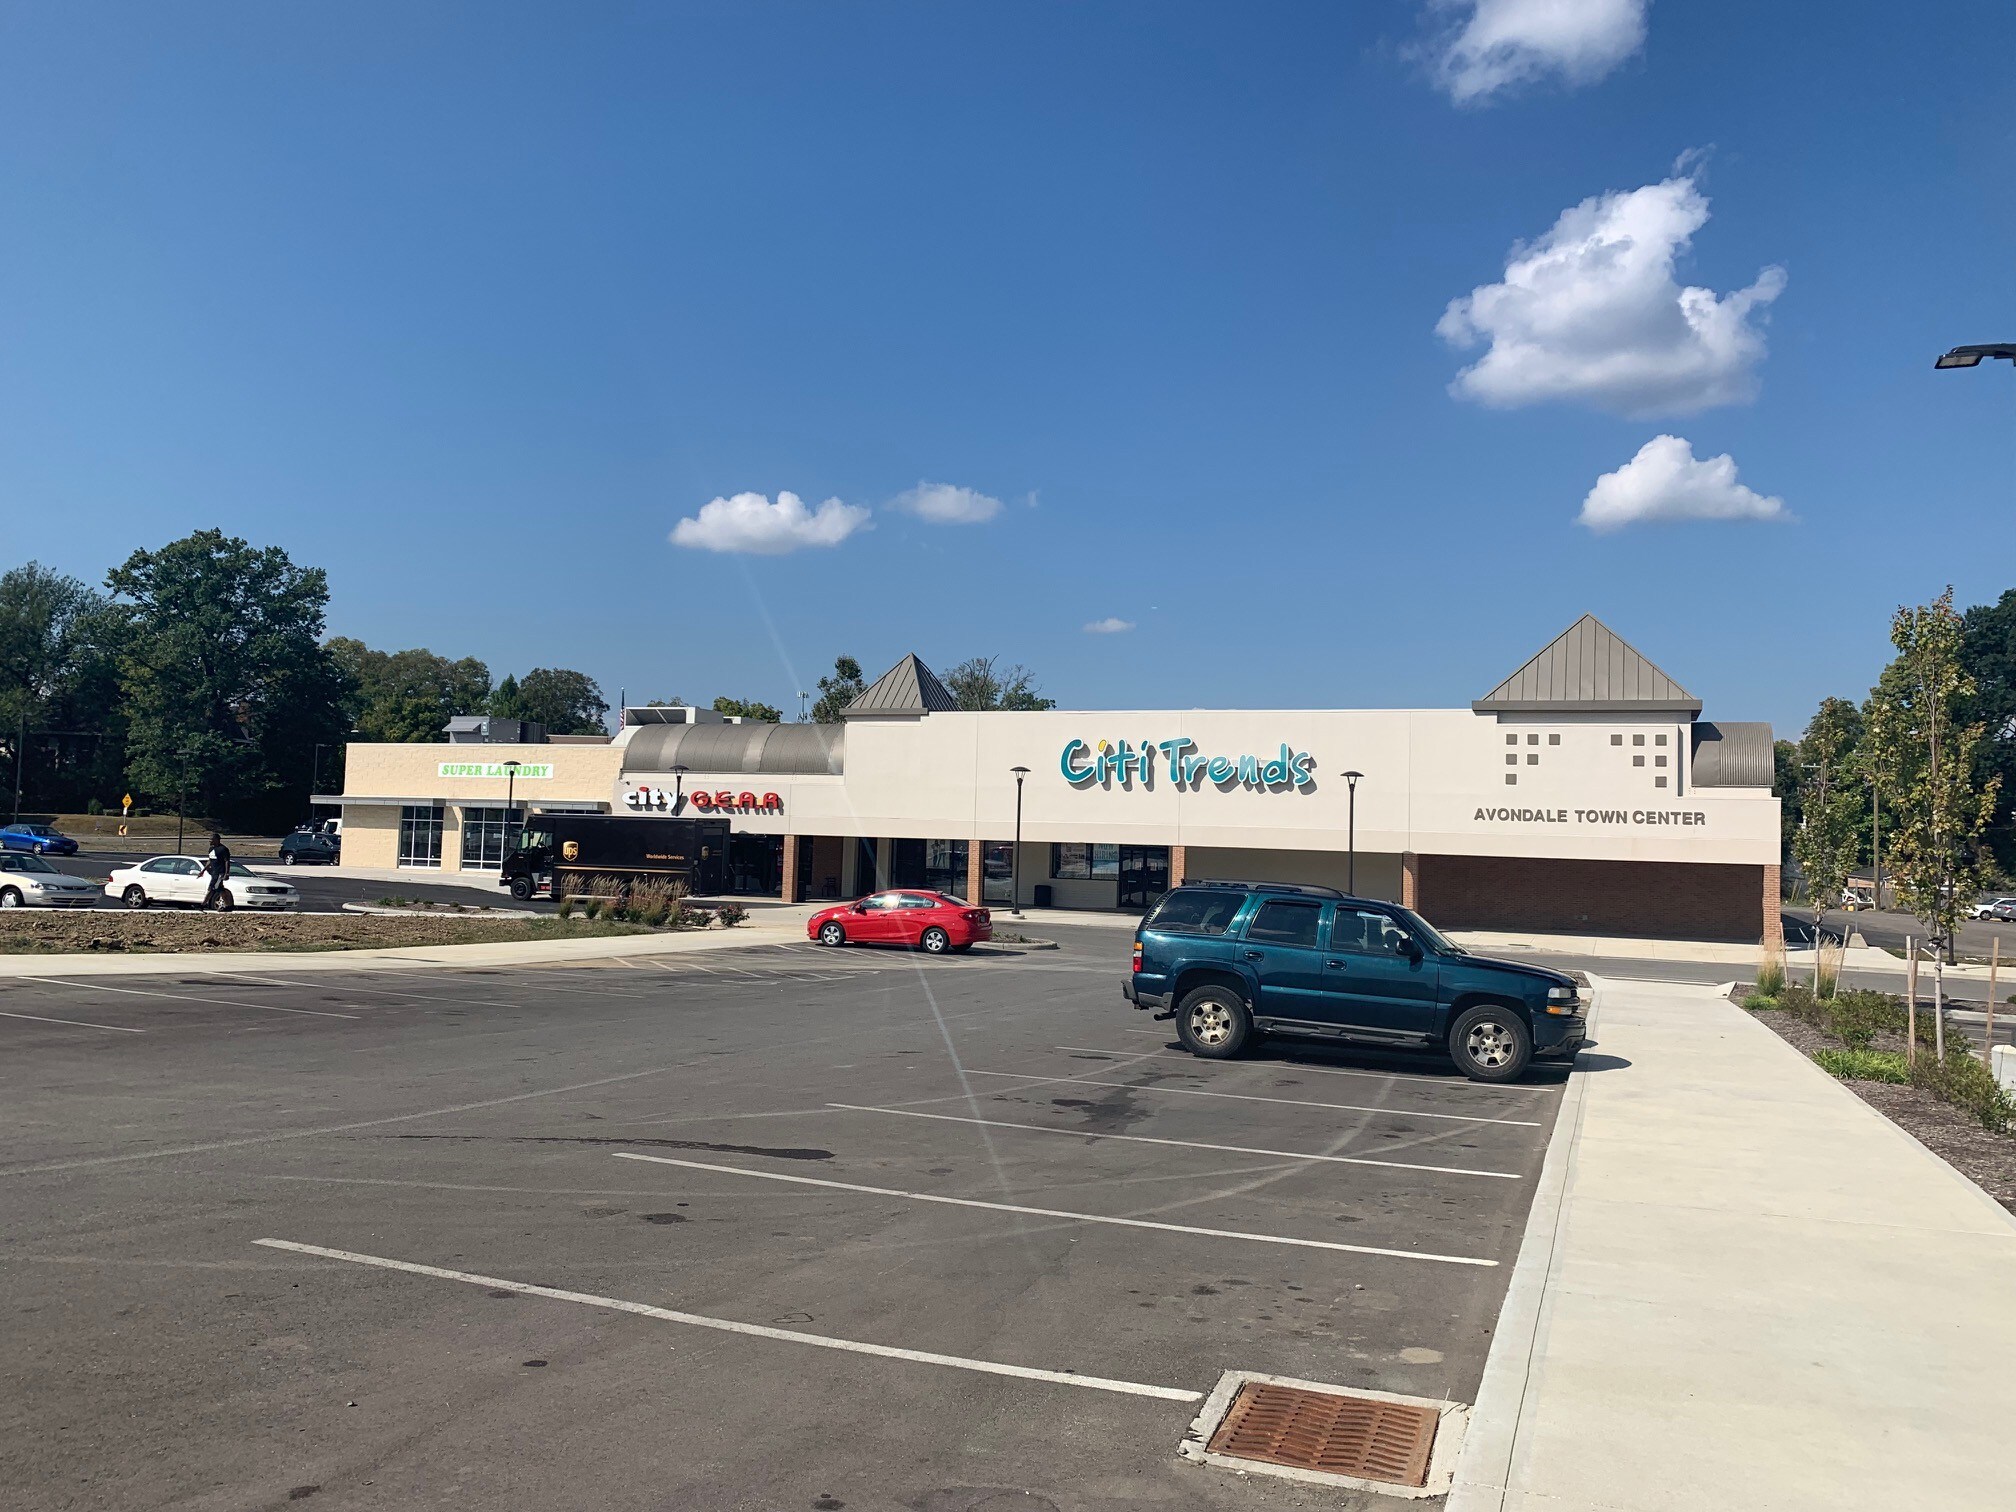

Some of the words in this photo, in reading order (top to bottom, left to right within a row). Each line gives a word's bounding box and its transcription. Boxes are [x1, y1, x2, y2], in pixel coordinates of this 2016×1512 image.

[1060, 737, 1149, 783] Citi
[1159, 737, 1311, 785] Trends
[442, 765, 482, 776] SUPER
[486, 765, 549, 777] LAUNDRY
[1474, 808, 1567, 823] AVONDALE
[1574, 809, 1628, 824] TOWN
[1632, 811, 1706, 826] CENTER
[564, 846, 578, 858] ups
